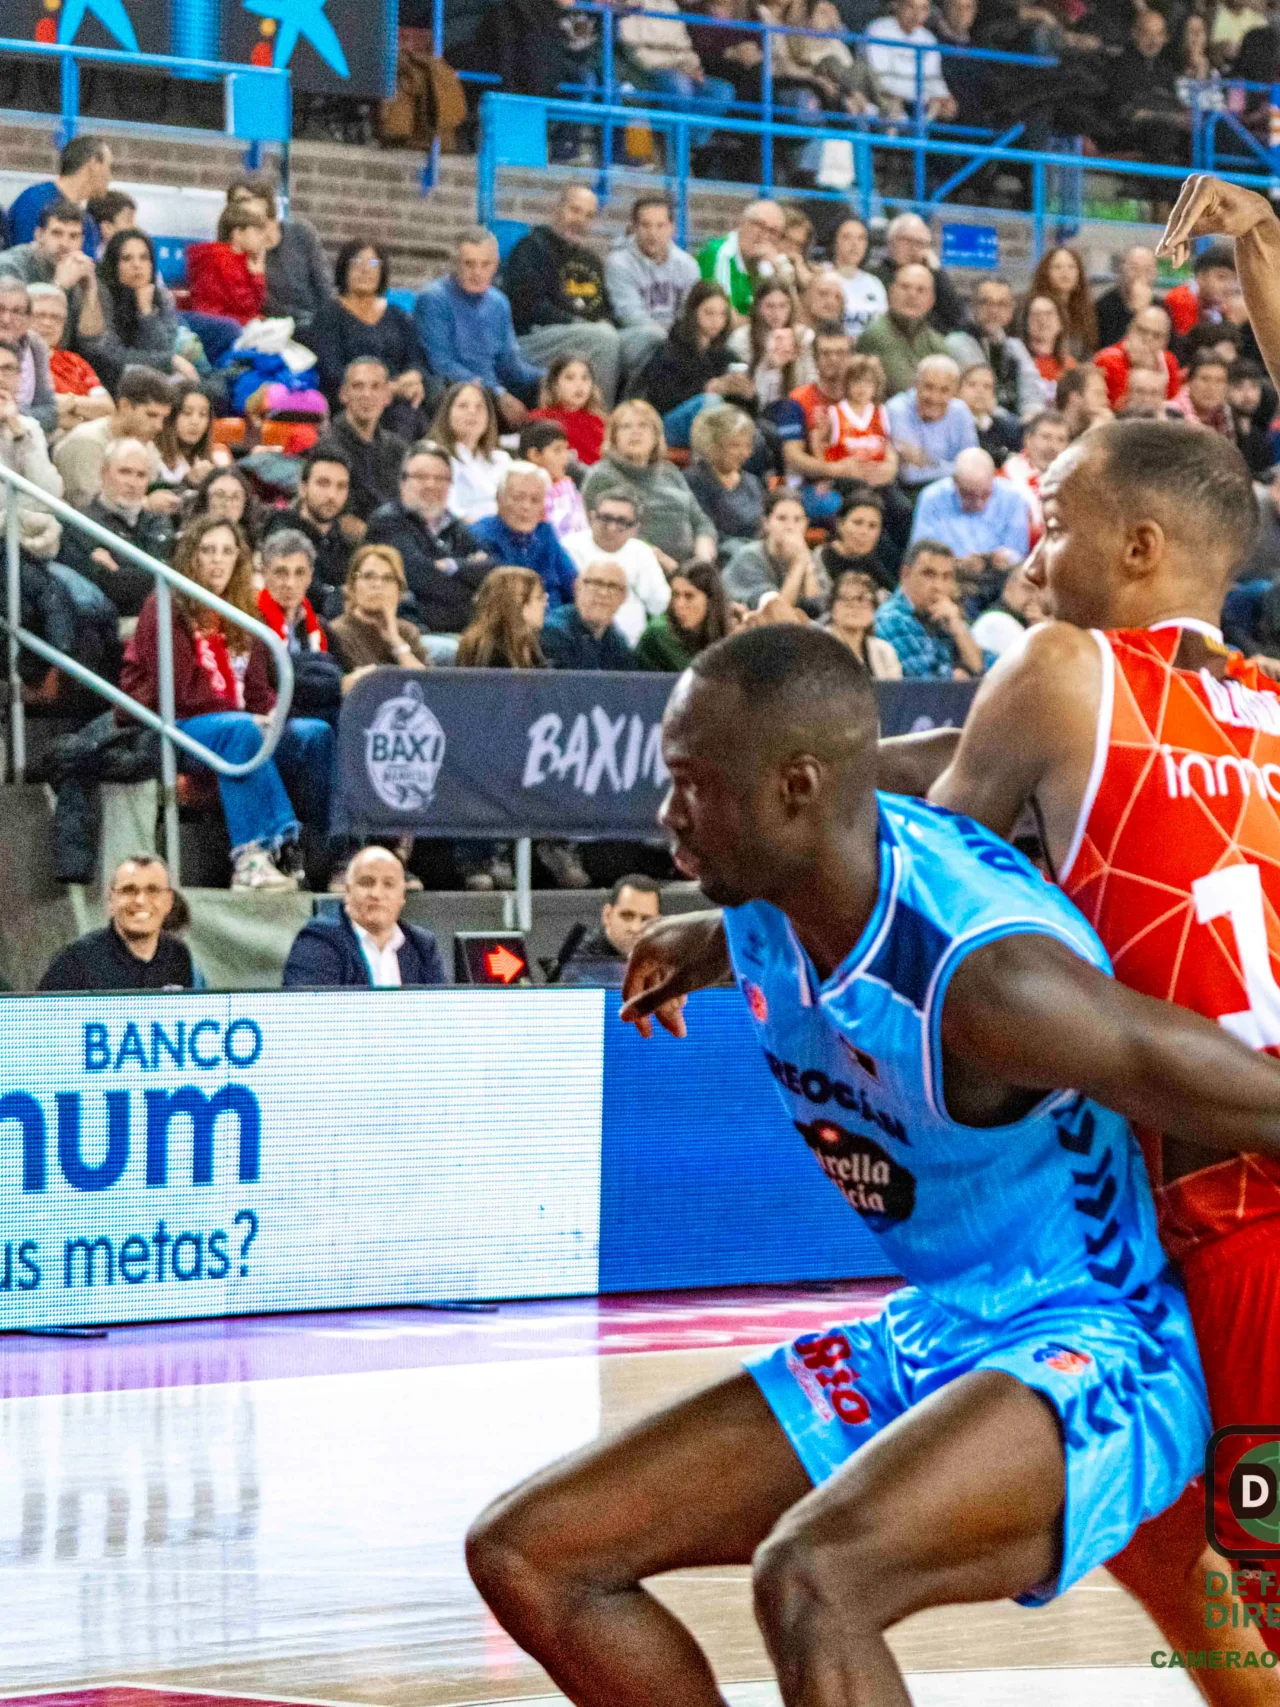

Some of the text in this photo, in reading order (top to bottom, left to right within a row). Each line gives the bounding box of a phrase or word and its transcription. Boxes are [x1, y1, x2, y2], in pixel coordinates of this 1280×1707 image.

[372, 733, 442, 763] BAXI
[83, 1018, 263, 1074] BANCO
[64, 1209, 259, 1289] metas?
